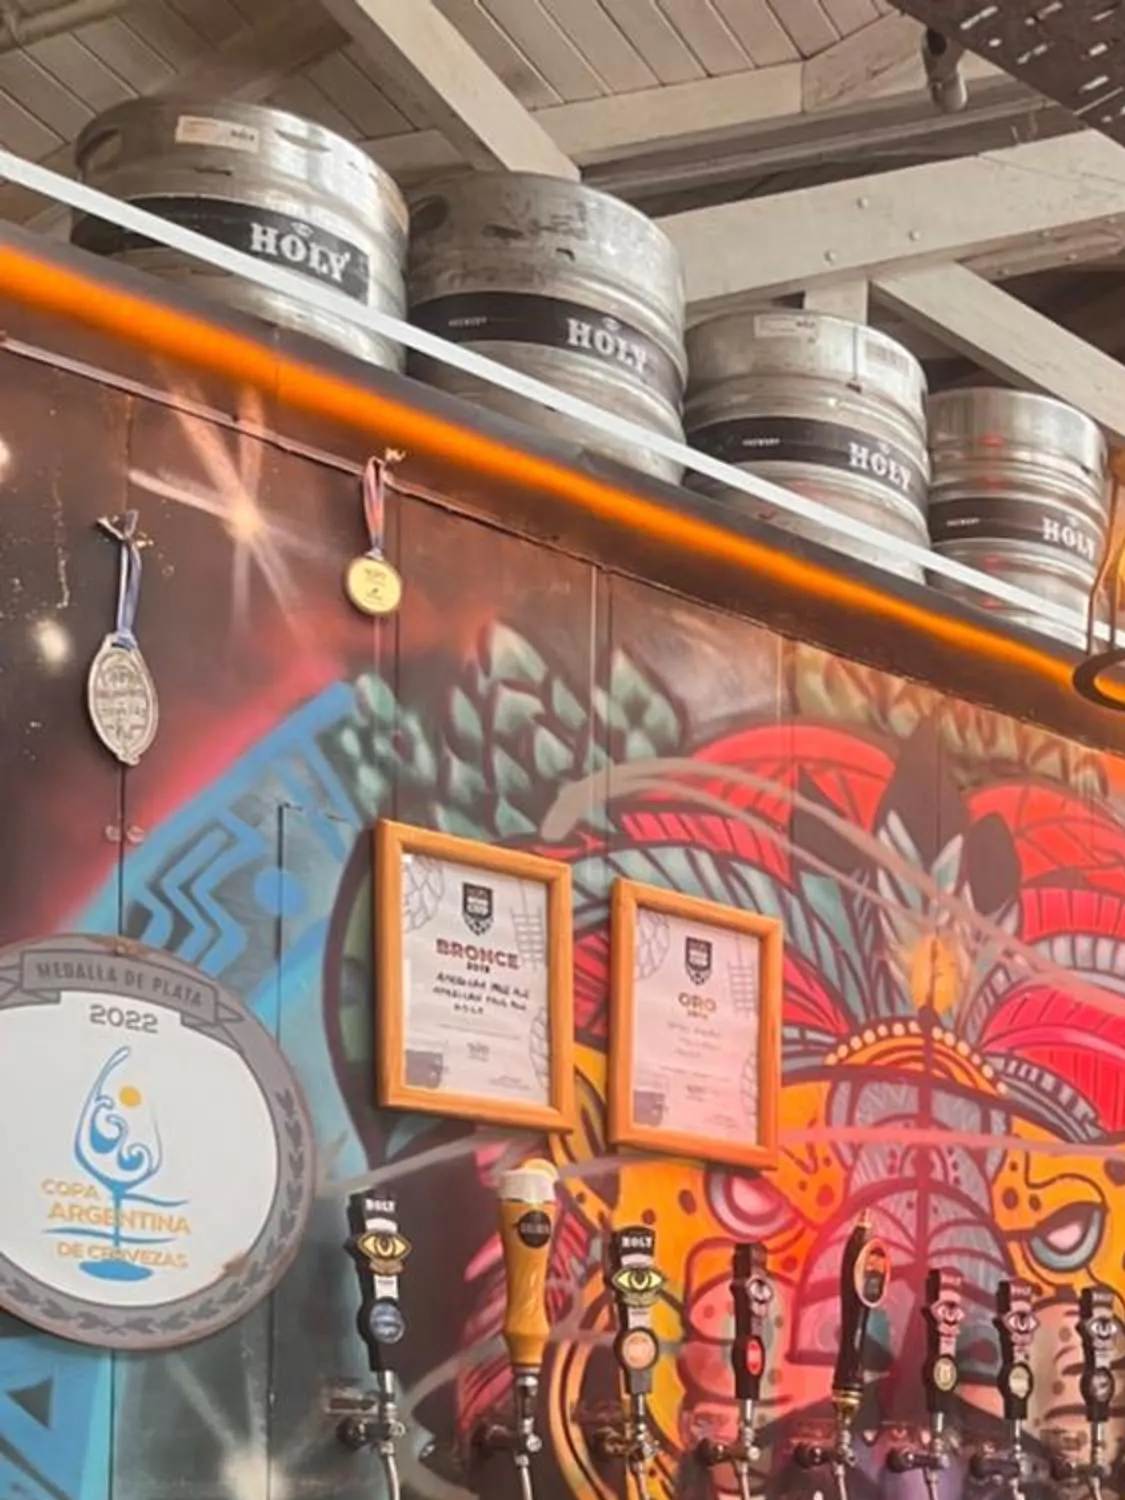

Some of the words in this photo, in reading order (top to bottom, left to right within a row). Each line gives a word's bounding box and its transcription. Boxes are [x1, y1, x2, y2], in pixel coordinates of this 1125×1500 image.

[251, 222, 350, 282] HOLY
[567, 318, 649, 374] HOLY
[849, 442, 912, 493] HOLY
[1042, 516, 1096, 561] HOLY
[436, 938, 519, 971] BRONCE
[36, 962, 118, 982] MEDALLA
[124, 970, 145, 989] DE
[152, 977, 203, 1005] PLATA
[679, 992, 717, 1012] ORO
[89, 1004, 159, 1034] 2022
[41, 1178, 99, 1199] COPA
[47, 1202, 192, 1235] ARGENTINA
[57, 1242, 84, 1259] DE
[87, 1245, 190, 1268] CERVEZAS
